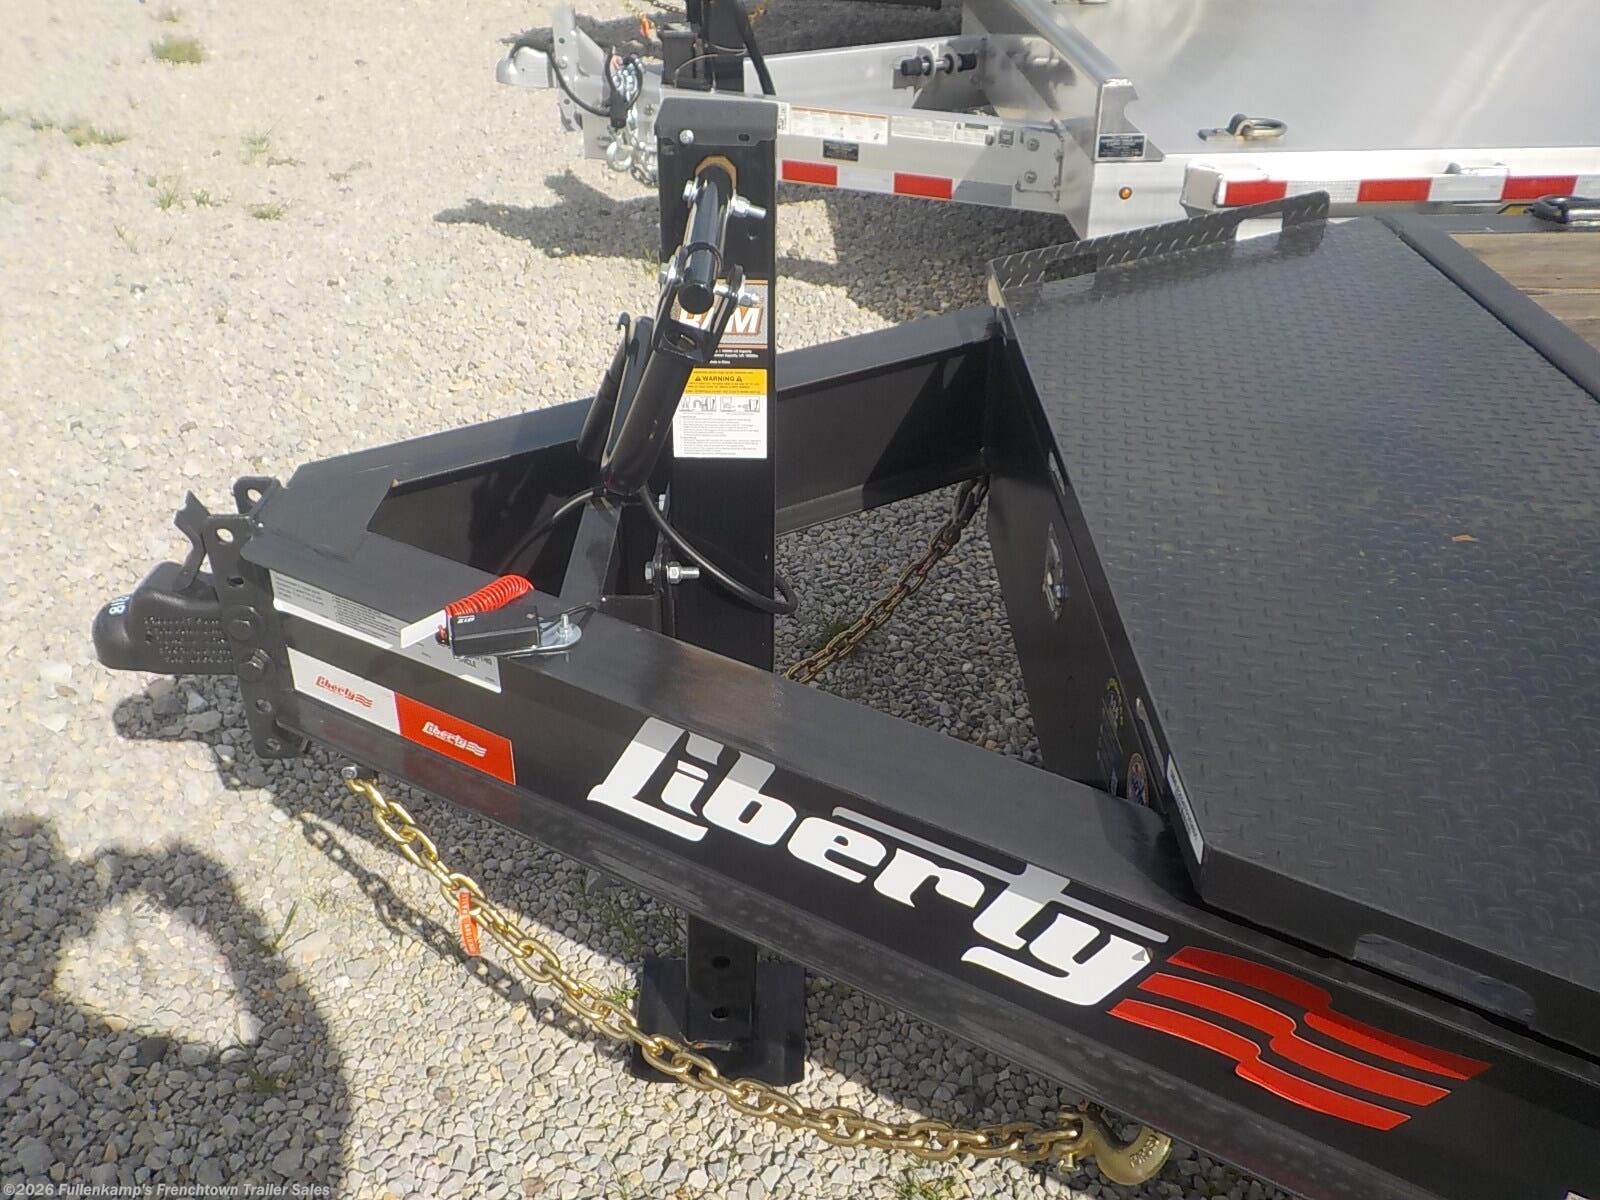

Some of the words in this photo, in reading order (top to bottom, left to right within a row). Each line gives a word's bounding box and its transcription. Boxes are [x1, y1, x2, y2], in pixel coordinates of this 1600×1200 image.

[316, 676, 355, 701] Liberty
[422, 721, 467, 750] Liberty
[586, 717, 1169, 1006] Liberty
